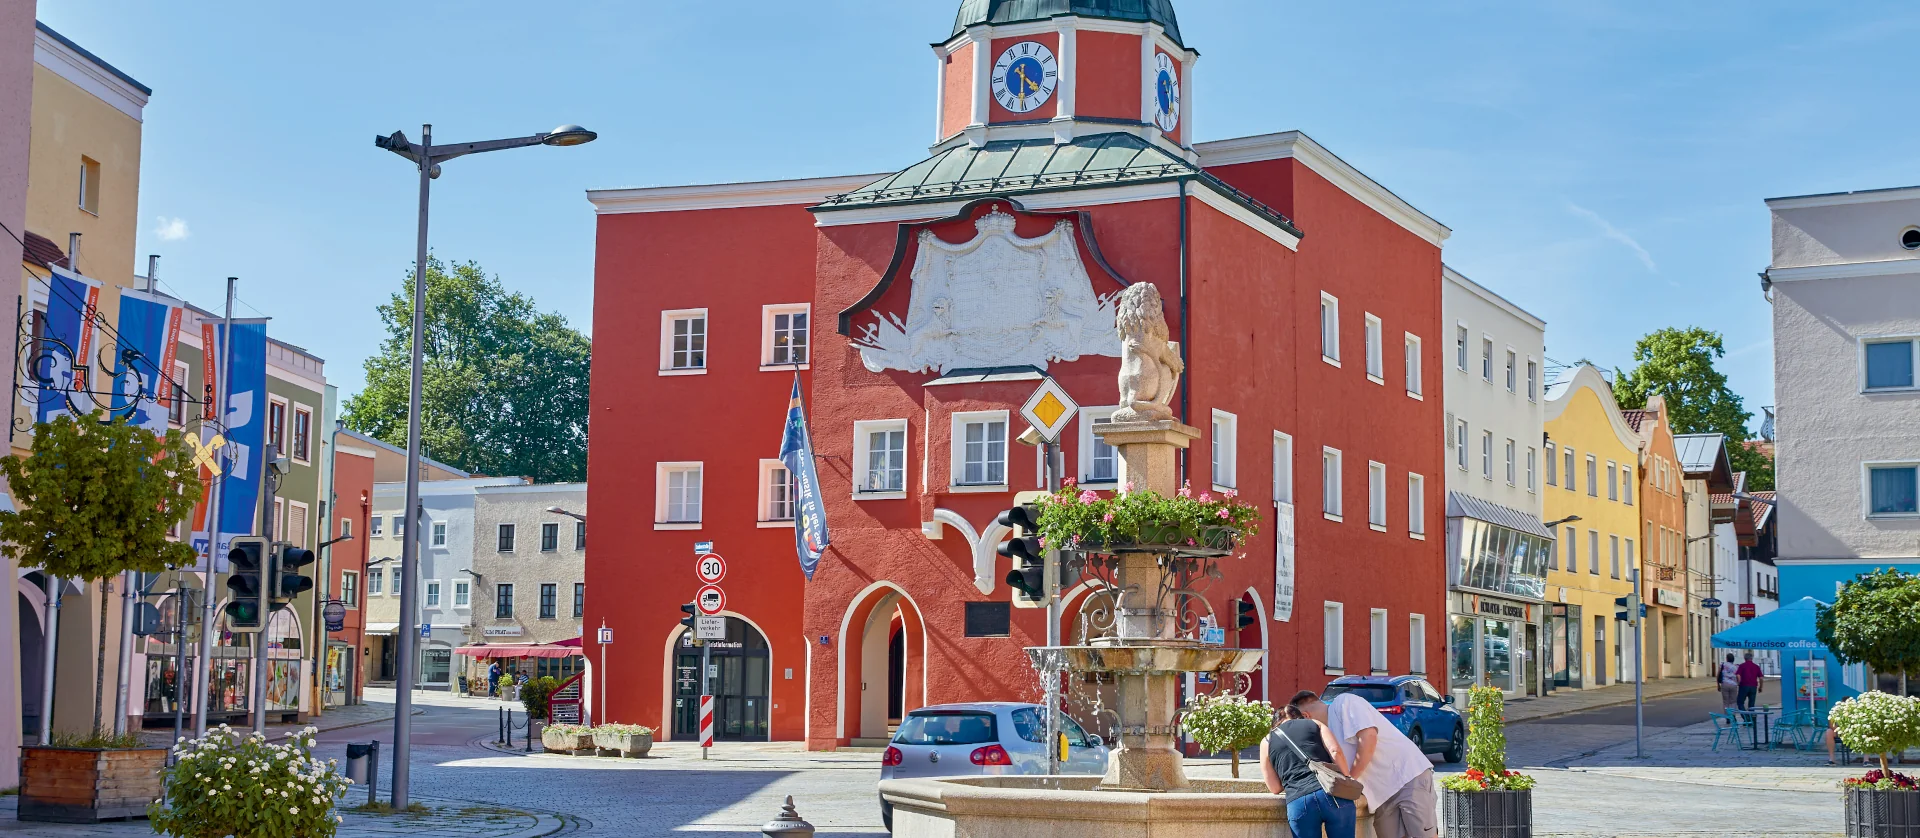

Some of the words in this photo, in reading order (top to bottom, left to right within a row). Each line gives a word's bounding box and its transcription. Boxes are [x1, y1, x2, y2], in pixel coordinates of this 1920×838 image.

[703, 562, 720, 575] 30
[1744, 640, 1786, 648] francisco
[1788, 640, 1817, 648] coffee
